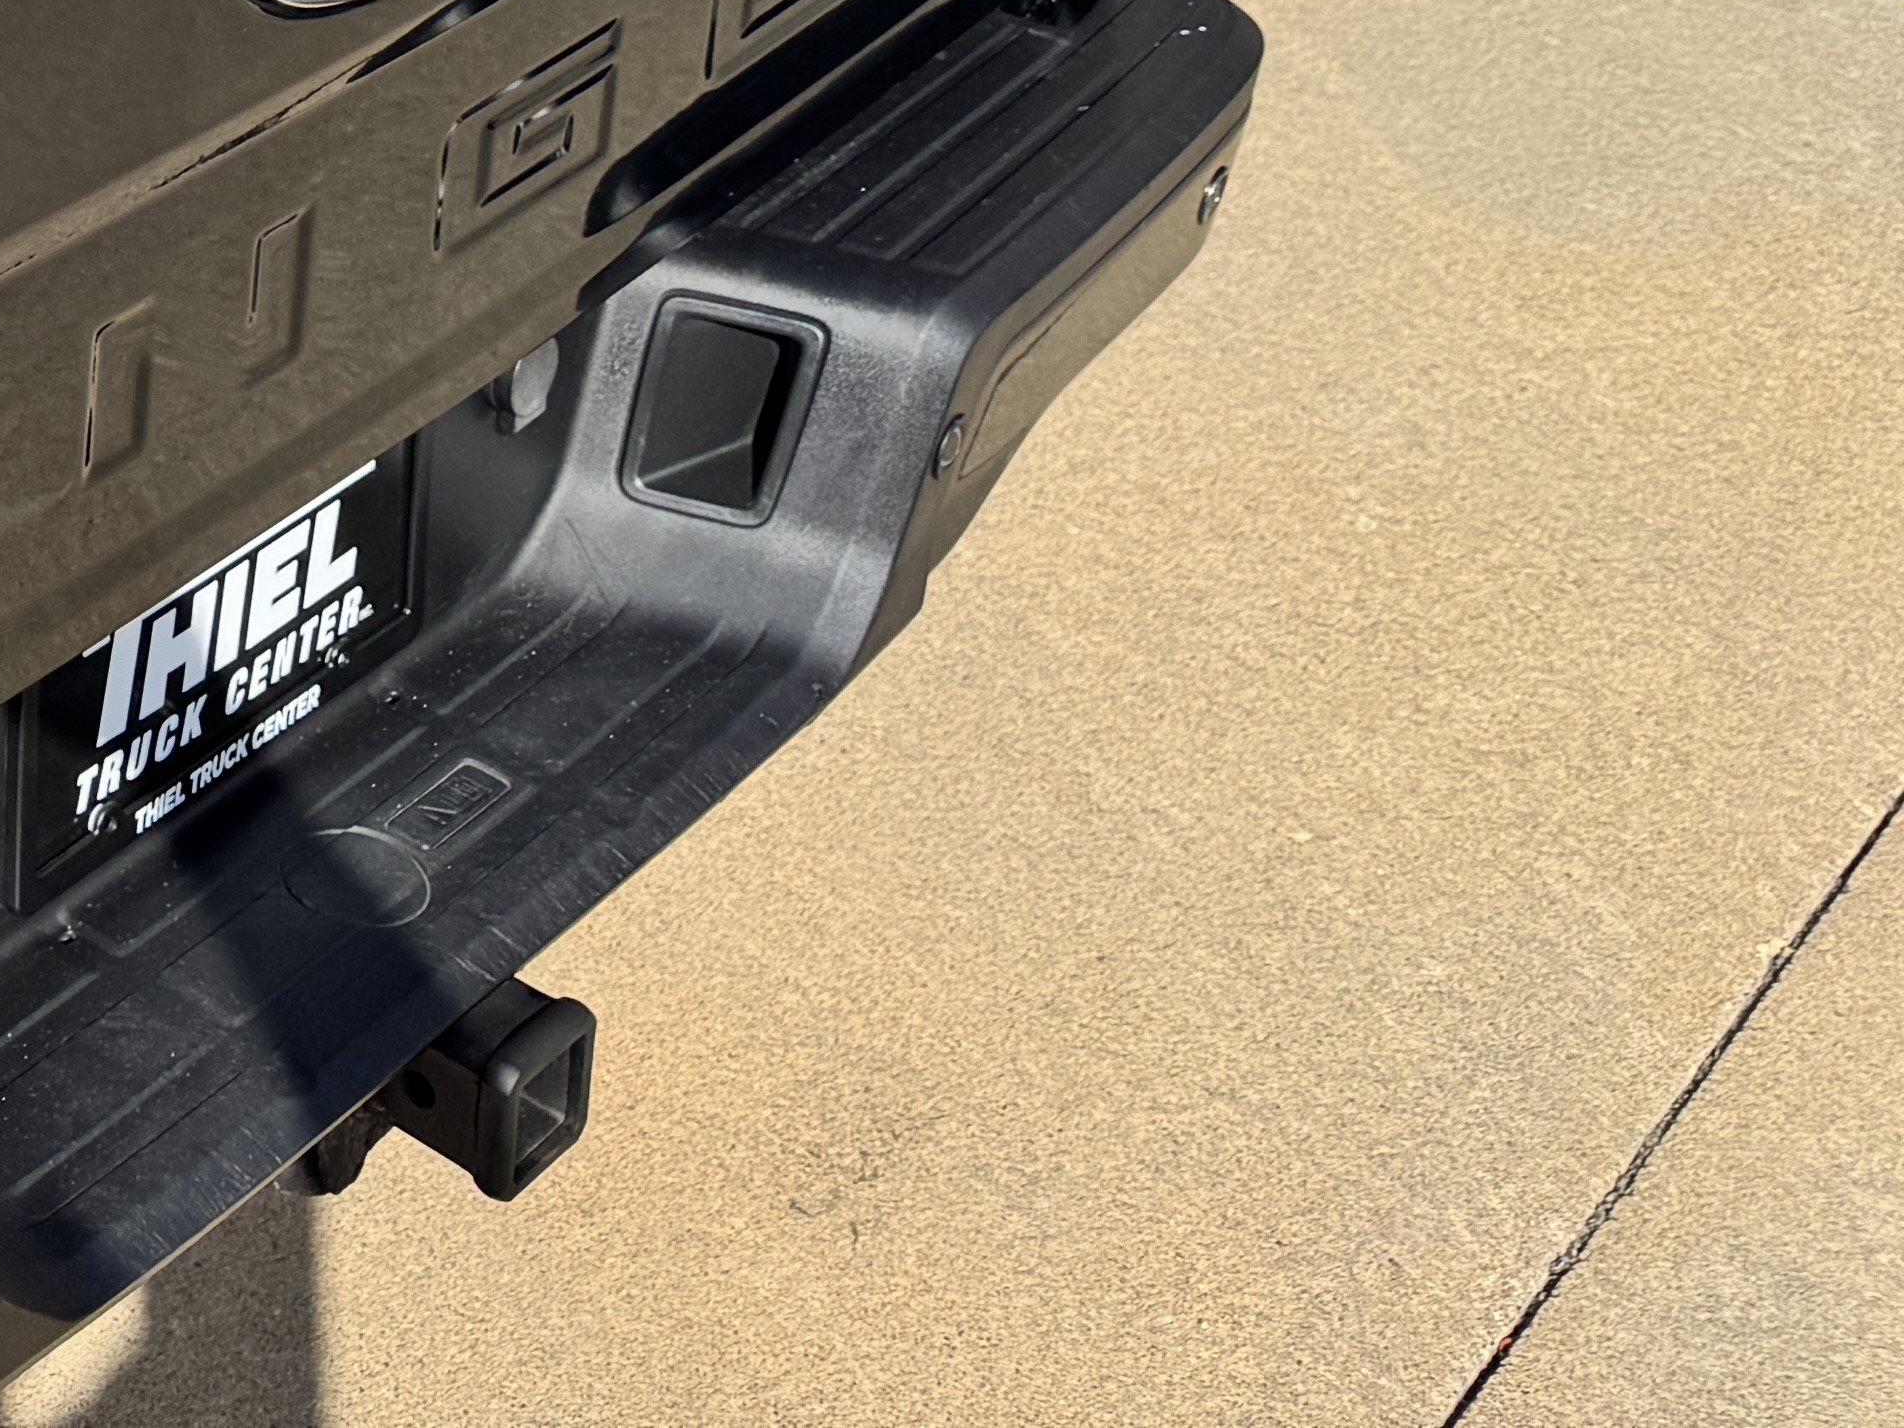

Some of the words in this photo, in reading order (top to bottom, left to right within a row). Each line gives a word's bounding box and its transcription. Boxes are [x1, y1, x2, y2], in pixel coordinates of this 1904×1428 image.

[75, 693, 208, 816] TRUCK
[224, 585, 364, 716] CENTER
[81, 458, 377, 749] THIEL
[135, 781, 186, 835] THIEL
[190, 732, 251, 794] TRUCK
[252, 683, 322, 750] CENTER
